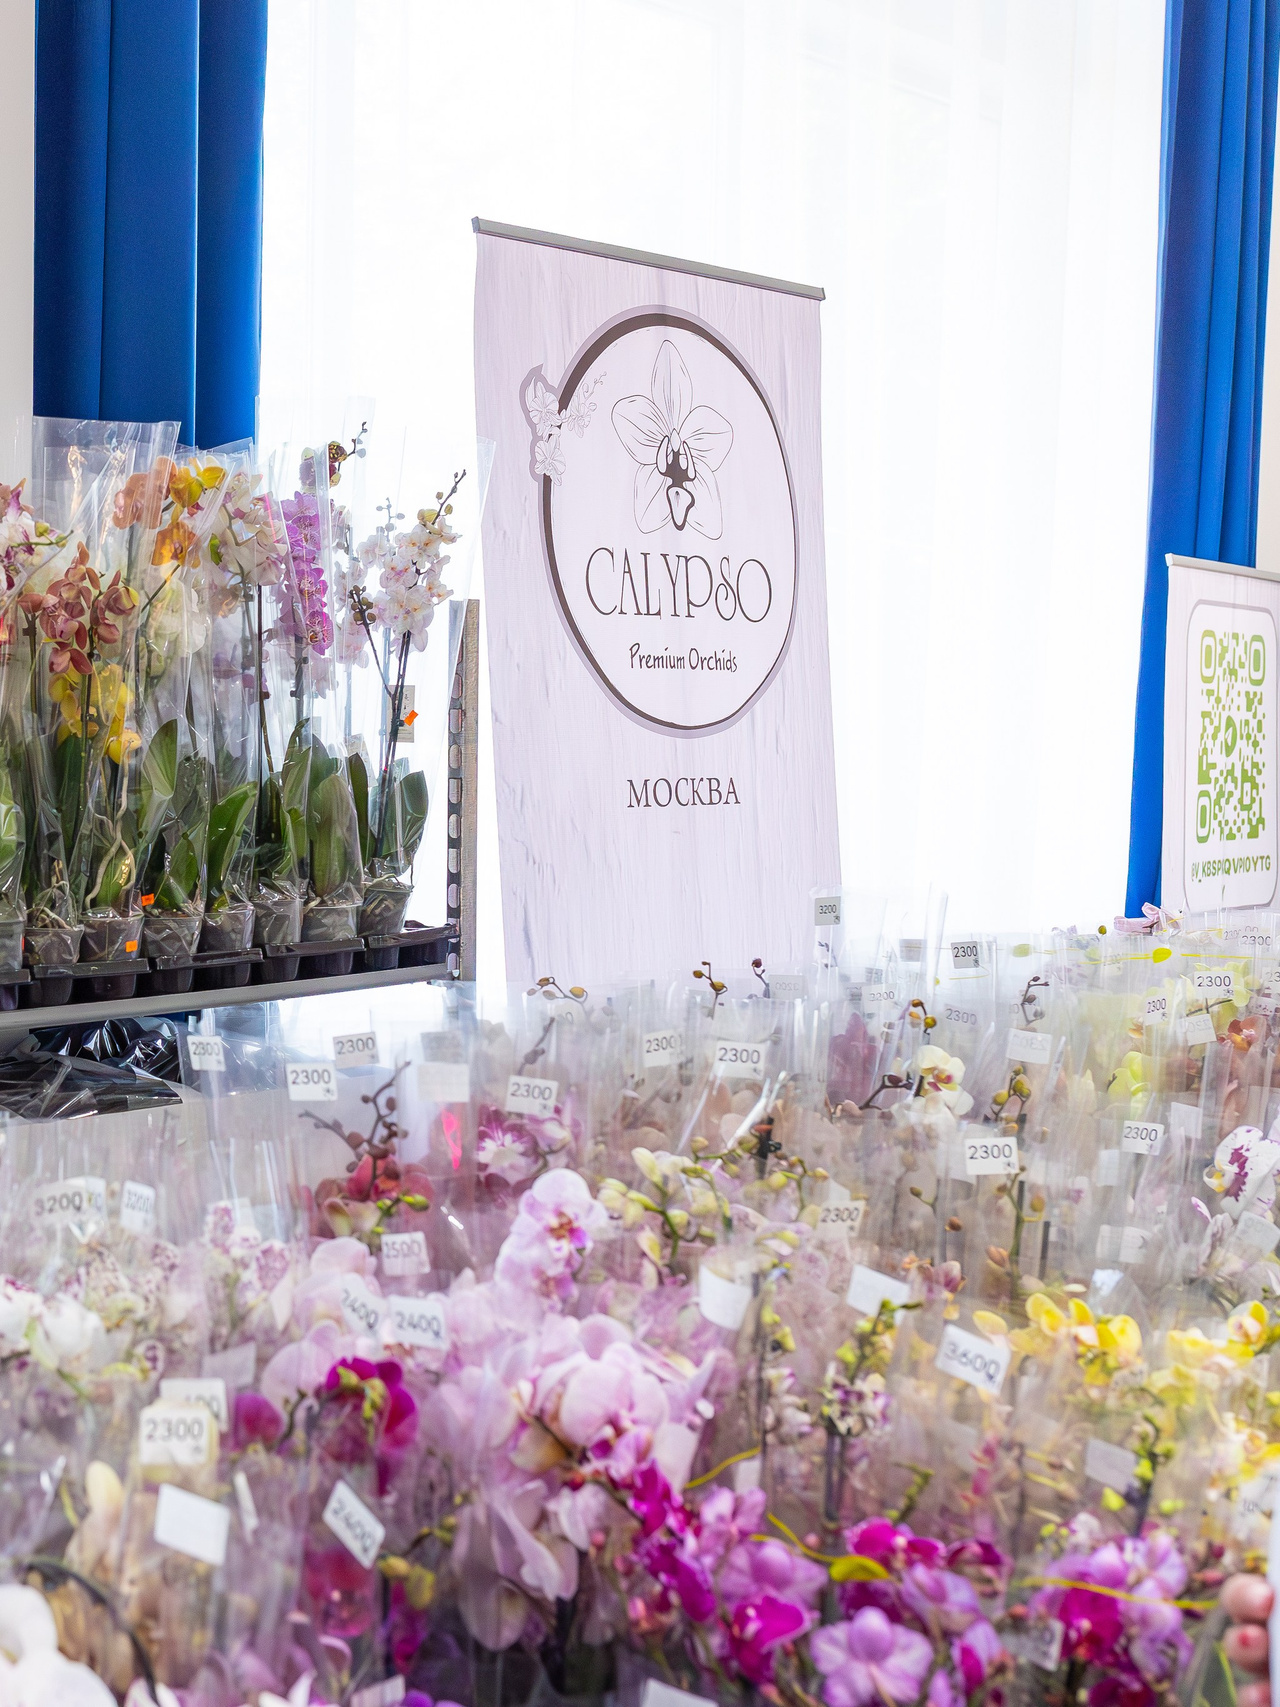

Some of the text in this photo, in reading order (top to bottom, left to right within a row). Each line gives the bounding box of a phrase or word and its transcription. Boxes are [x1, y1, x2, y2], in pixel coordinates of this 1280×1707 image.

[585, 546, 773, 623] CALYPSO
[628, 641, 738, 673] Premium Orchids
[626, 776, 741, 808] МОСКВА
[819, 904, 837, 914] 3200
[1241, 935, 1271, 946] 2300
[954, 945, 978, 958] 2300
[1197, 975, 1232, 987] 2300
[1147, 998, 1167, 1013] 2300
[945, 1008, 978, 1025] 2300
[191, 1041, 220, 1056] 2300
[336, 1036, 376, 1055] 2300
[645, 1035, 677, 1053] 2300
[718, 1047, 761, 1064] 2300
[290, 1069, 332, 1085] 2300
[510, 1082, 552, 1101] 2300
[1124, 1125, 1158, 1142] 2300
[968, 1144, 1013, 1160] 2300
[820, 1206, 860, 1223] 2300
[395, 1311, 440, 1334] 2400
[145, 1417, 204, 1442] 2300
